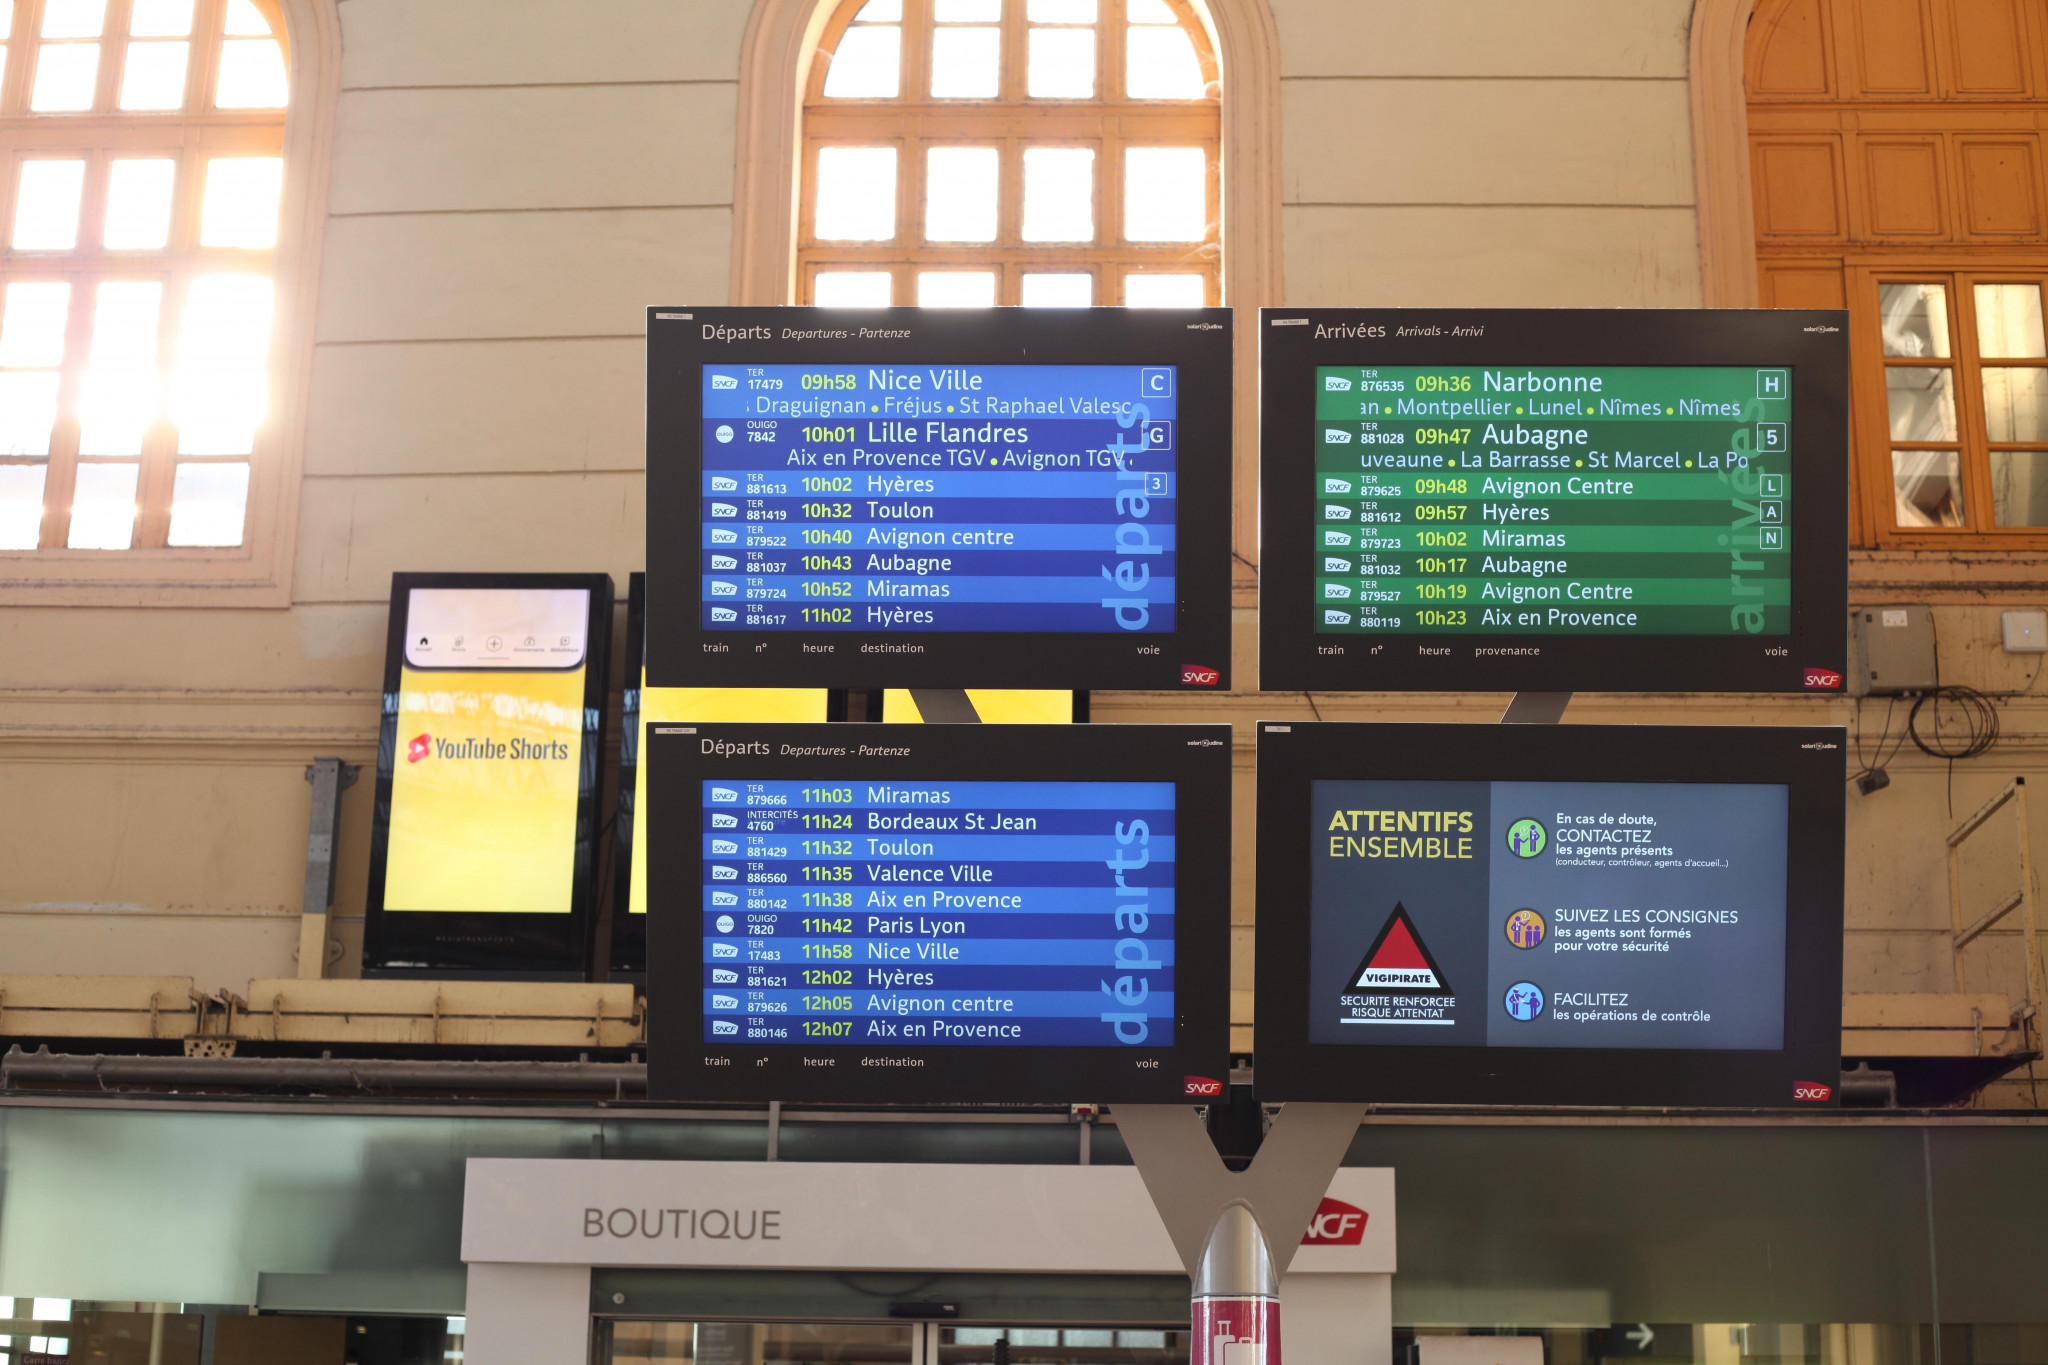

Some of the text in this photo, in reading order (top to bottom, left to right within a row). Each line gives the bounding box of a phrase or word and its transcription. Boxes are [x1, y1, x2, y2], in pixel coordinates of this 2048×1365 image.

[703, 324, 771, 343] Départs
[782, 327, 911, 341] Departures Partenze
[1315, 323, 1386, 339] Arrivées
[1396, 325, 1484, 336] Arrivals Arrivi
[801, 369, 982, 390] 09h58 Nice Ville
[1361, 370, 1378, 378] TER
[1416, 371, 1602, 392] 09h36 Narbonne
[748, 379, 783, 390] 17479
[1150, 374, 1164, 390] C
[1361, 381, 1404, 391] 876535
[1765, 378, 1778, 392] H
[757, 396, 1131, 418] Draguignan Fréjus St Raphael Valesc
[1398, 398, 1511, 419] Montpellier
[1530, 398, 1582, 415] Lunel
[1600, 399, 1661, 415] Nîmes
[1680, 399, 1741, 416] Nîmes
[802, 422, 1028, 443] 10h01 Lille Flandres
[1361, 422, 1378, 431] TER
[747, 431, 775, 442] 7842
[1150, 428, 1163, 443] G
[1361, 434, 1404, 444] 881028
[1416, 423, 1588, 450] 09h47 Aubagne
[1767, 430, 1777, 444] 5
[787, 449, 1125, 471] Aix en Provence TGV Avignon TGV
[1362, 451, 1748, 468] uveaune La Barrasse St Marcel La Po
[802, 475, 934, 496] 10h02 Hyères
[1152, 478, 1160, 490] 3
[1416, 477, 1633, 499] 09h48 Avignon Centre
[1768, 480, 1776, 491] L
[802, 501, 933, 518] 10h32 Toulon
[1102, 403, 1162, 630] départs
[1416, 503, 1549, 524] 09h57 Hyères
[1717, 397, 1765, 633] arrivées
[1766, 506, 1777, 518] A
[802, 527, 1014, 549] 10h40 Avignon centre
[1416, 529, 1566, 546] 10h02 Miramas
[1766, 532, 1776, 544] N
[802, 554, 951, 575] 10h43 Aubagne
[703, 643, 728, 652] train
[803, 643, 834, 652] heure
[861, 643, 924, 653] destination
[1137, 645, 1160, 654] voie
[1182, 673, 1217, 682] SNCF
[1805, 676, 1839, 685] SNCF
[436, 738, 568, 760] YouTube Shorts
[802, 786, 950, 803] 11h03 Miramas
[747, 809, 798, 819] INTERCITÉS
[802, 812, 1036, 830] 11h24 Bordeaux St Jean
[1328, 810, 1473, 833] ATTENTIFS
[1557, 813, 1571, 824] En
[1599, 813, 1614, 824] de
[1618, 813, 1657, 826] doute,
[1556, 829, 1651, 842] CONTACTEZ
[802, 838, 933, 855] 11h32 Toulon
[1330, 836, 1472, 858] ENSEMBLE
[1556, 843, 1673, 859] les agents présents
[1654, 860, 1682, 868] agents
[802, 865, 992, 882] 11h35 Valence Ville
[802, 890, 1021, 908] 11h38 Aix en Provence
[747, 914, 777, 923] OUIGO
[1555, 909, 1738, 923] SUIVEZ LES CONSIGNES
[802, 916, 965, 938] 11h42 Paris Lyon
[1101, 819, 1162, 1044] départs
[1555, 925, 1691, 940] les agents sont formés
[802, 942, 959, 959] 11h58 Nice Ville
[1555, 941, 1669, 953] pour votre sécurité
[1366, 974, 1431, 983] VIGIPIRATE
[1341, 996, 1455, 1007] SECURITE RENFORCEE
[1554, 993, 1628, 1006] FACILITEZ
[1352, 1008, 1444, 1018] RISQUE ATTENTAT
[1553, 1008, 1710, 1023] les opérations de contrôle
[1185, 1084, 1220, 1093] SNCF
[1794, 1088, 1829, 1098] SNCF
[584, 1208, 781, 1240] BOUTIQUE
[1306, 1213, 1362, 1239] NCF
